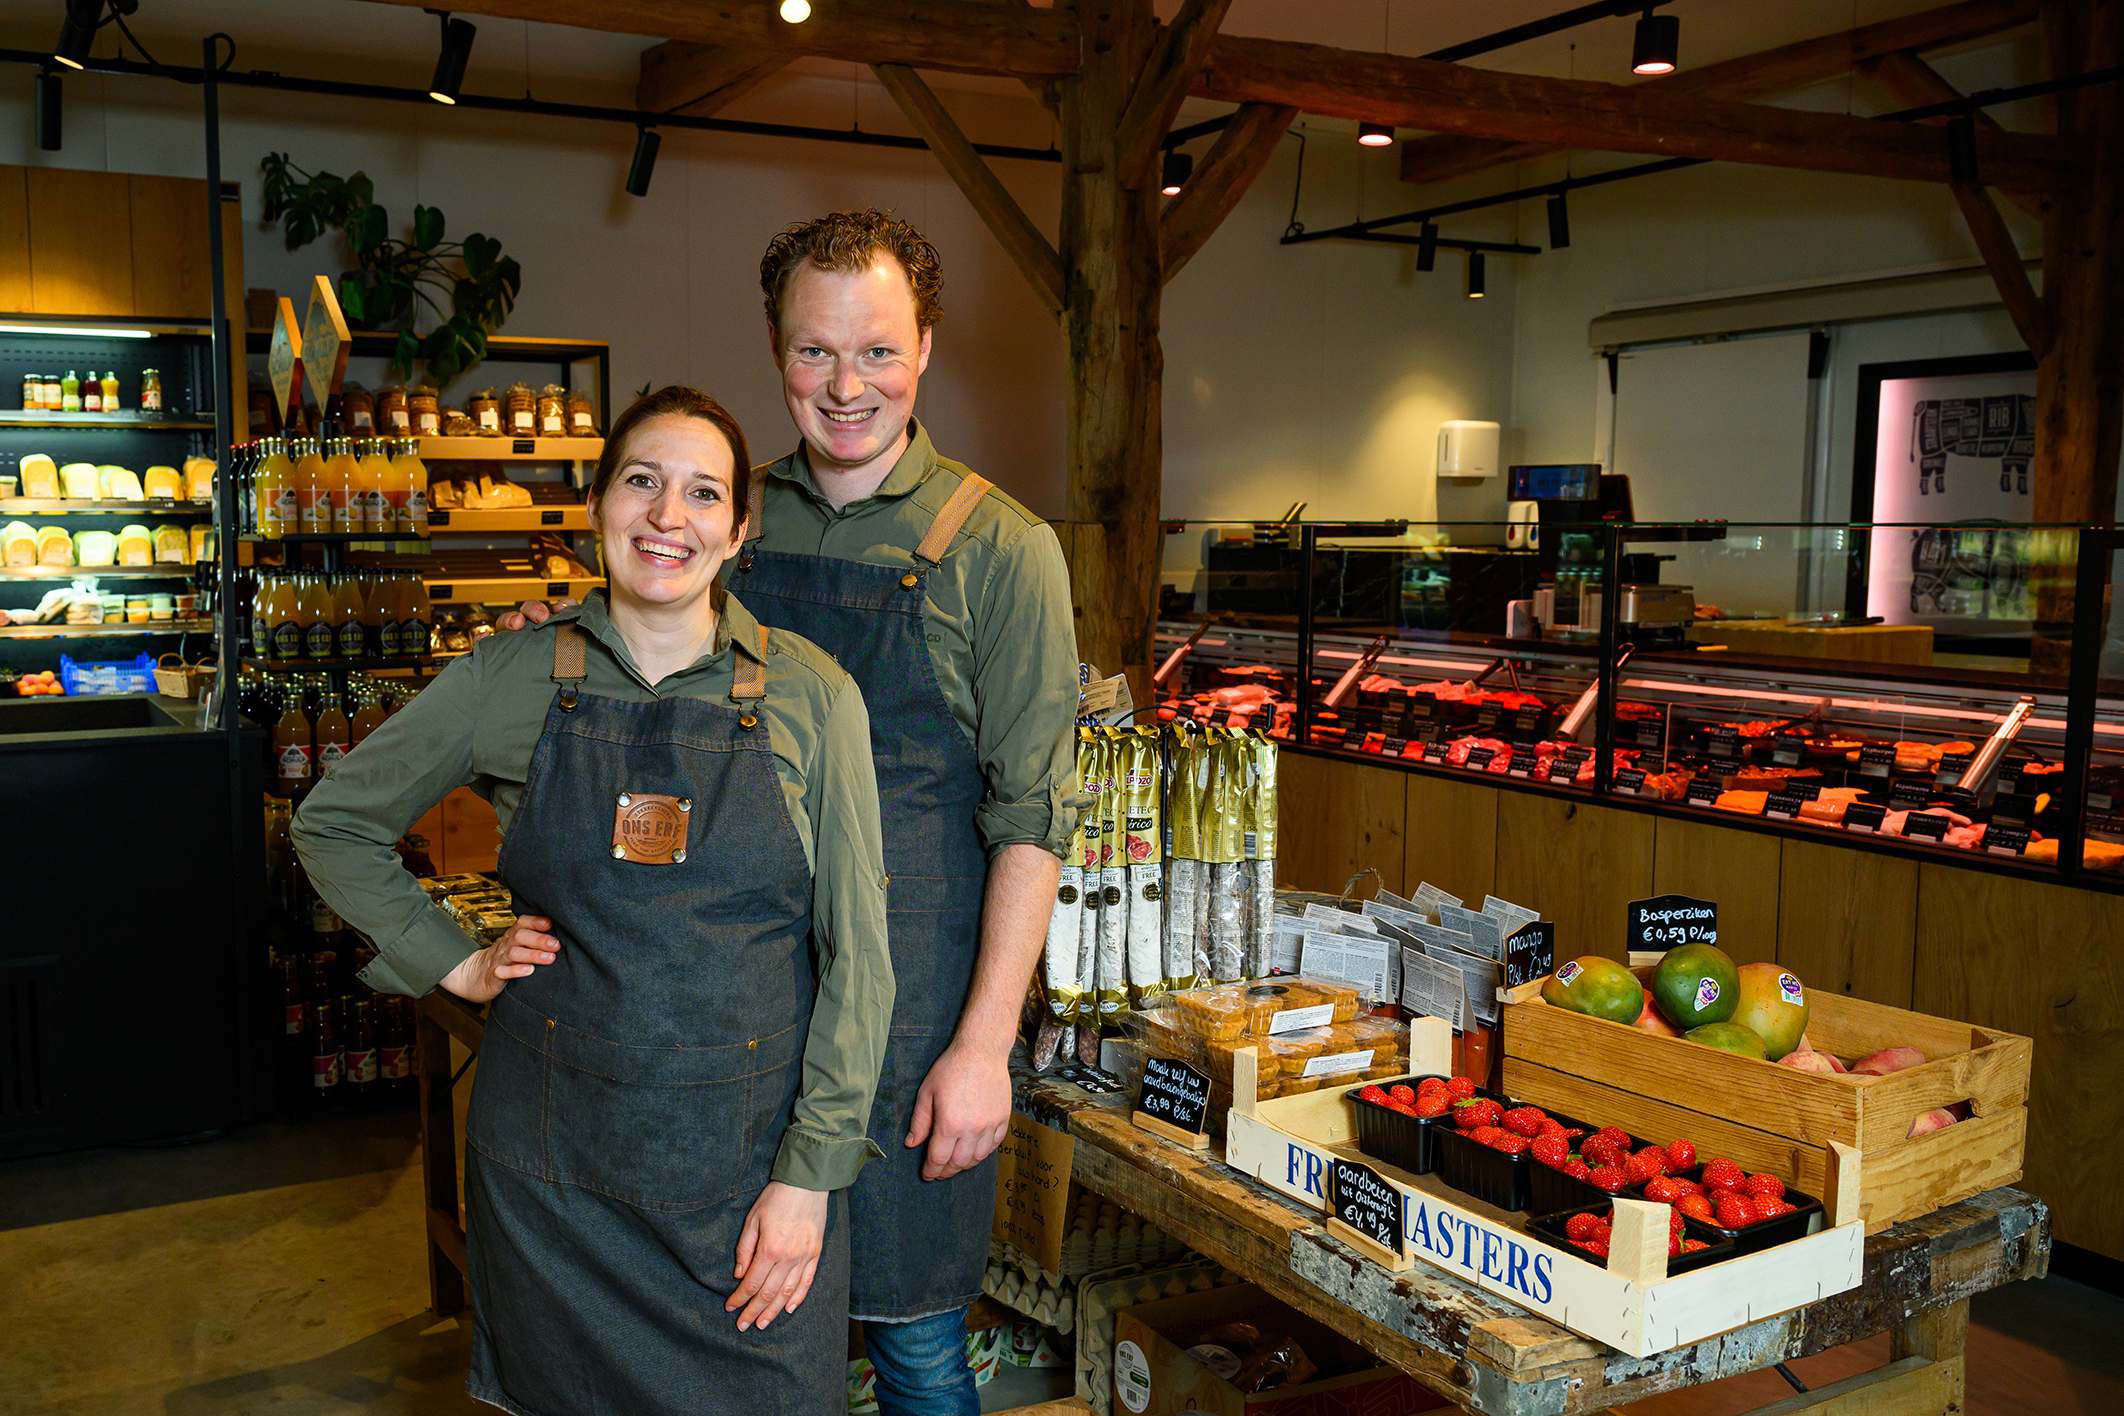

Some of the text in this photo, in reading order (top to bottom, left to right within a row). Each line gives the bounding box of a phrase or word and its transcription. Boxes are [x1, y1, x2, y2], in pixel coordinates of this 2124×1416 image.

[1989, 406, 2010, 428] RIB
[622, 819, 682, 838] ONS ERF
[1103, 874, 1117, 882] FREE
[1142, 872, 1157, 880] FREE
[1085, 880, 1099, 888] FREE
[1036, 1158, 1054, 1172] voor
